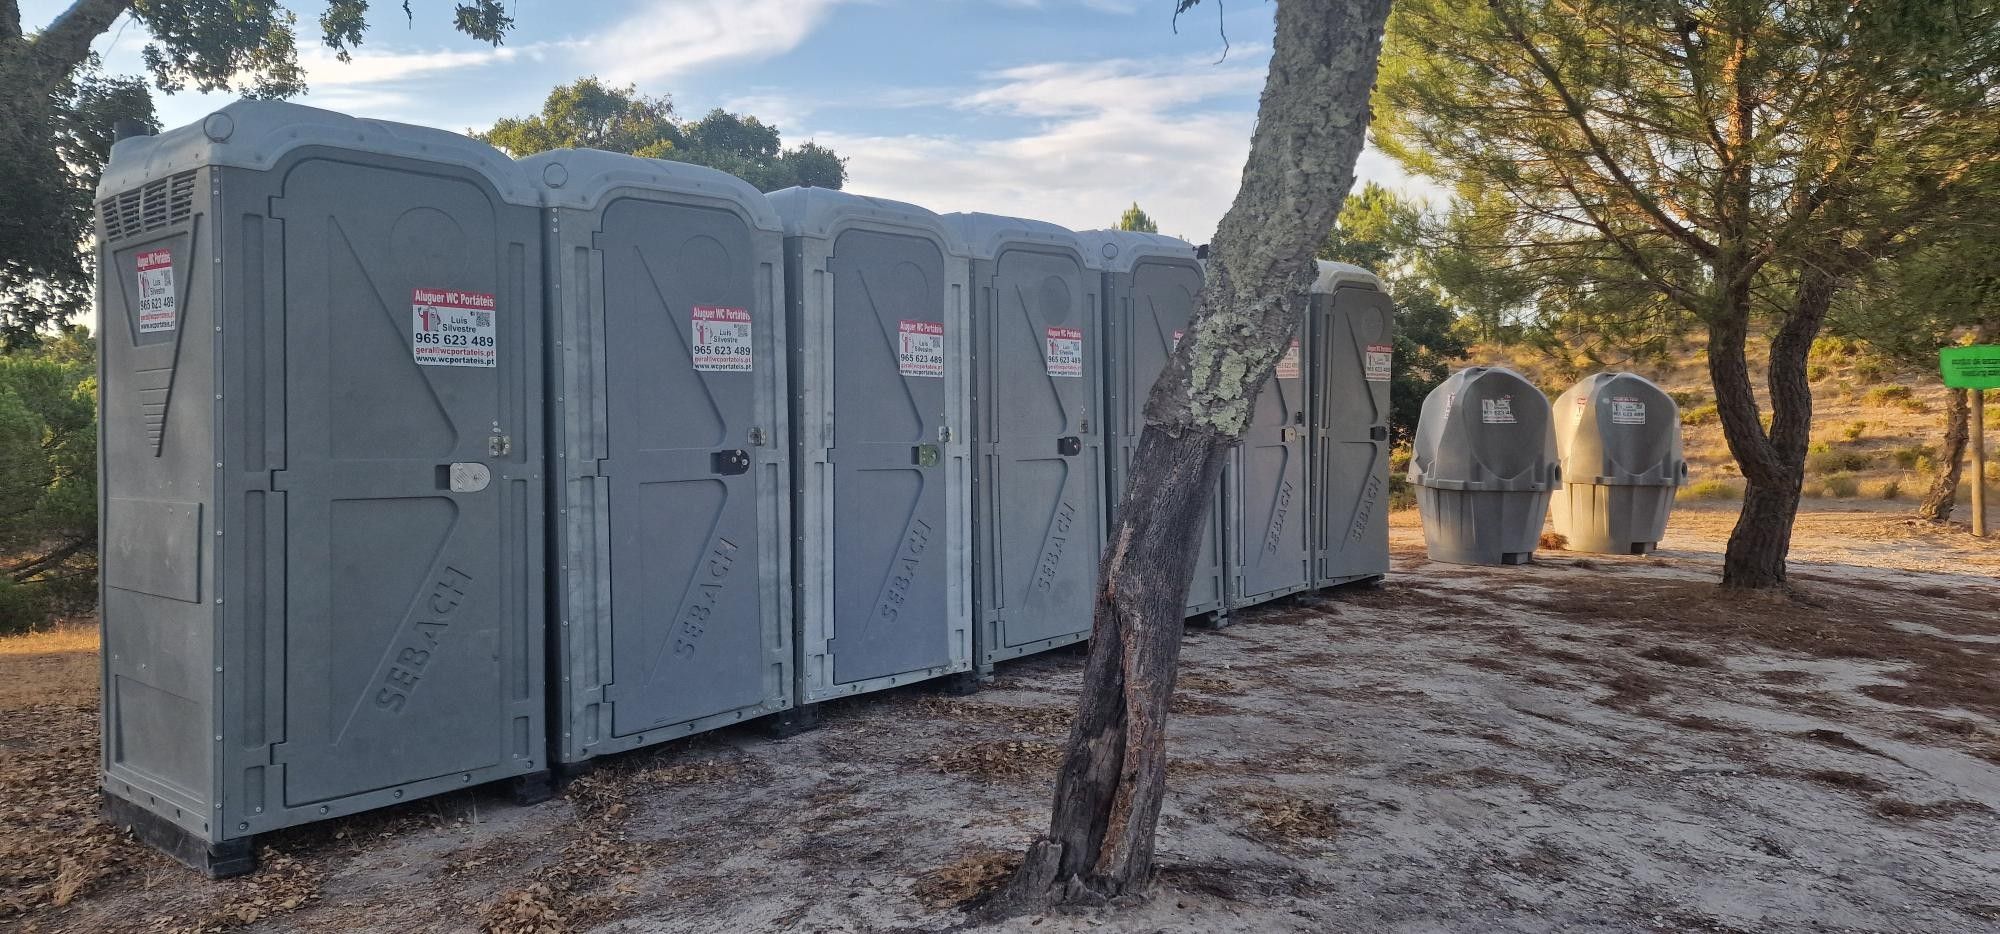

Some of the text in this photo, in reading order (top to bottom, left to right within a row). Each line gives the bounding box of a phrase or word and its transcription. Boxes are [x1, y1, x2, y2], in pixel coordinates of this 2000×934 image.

[140, 297, 174, 311] 965 623 489
[415, 290, 494, 307] Aluguer WC Portáteis
[451, 316, 468, 324] Luis
[693, 307, 715, 320] Aluguer
[715, 308, 725, 319] WC
[442, 324, 476, 333] Silvestre
[415, 333, 494, 347] 965 623 489
[694, 346, 751, 356] 965 623 489
[415, 356, 495, 366] www.wcportateis.pt
[900, 354, 913, 362] 965
[915, 355, 928, 363] 623
[1038, 502, 1075, 592] SEBACH
[881, 519, 931, 622] SEBACH
[675, 537, 738, 661] SEBACH
[376, 566, 473, 712] SEBACH
